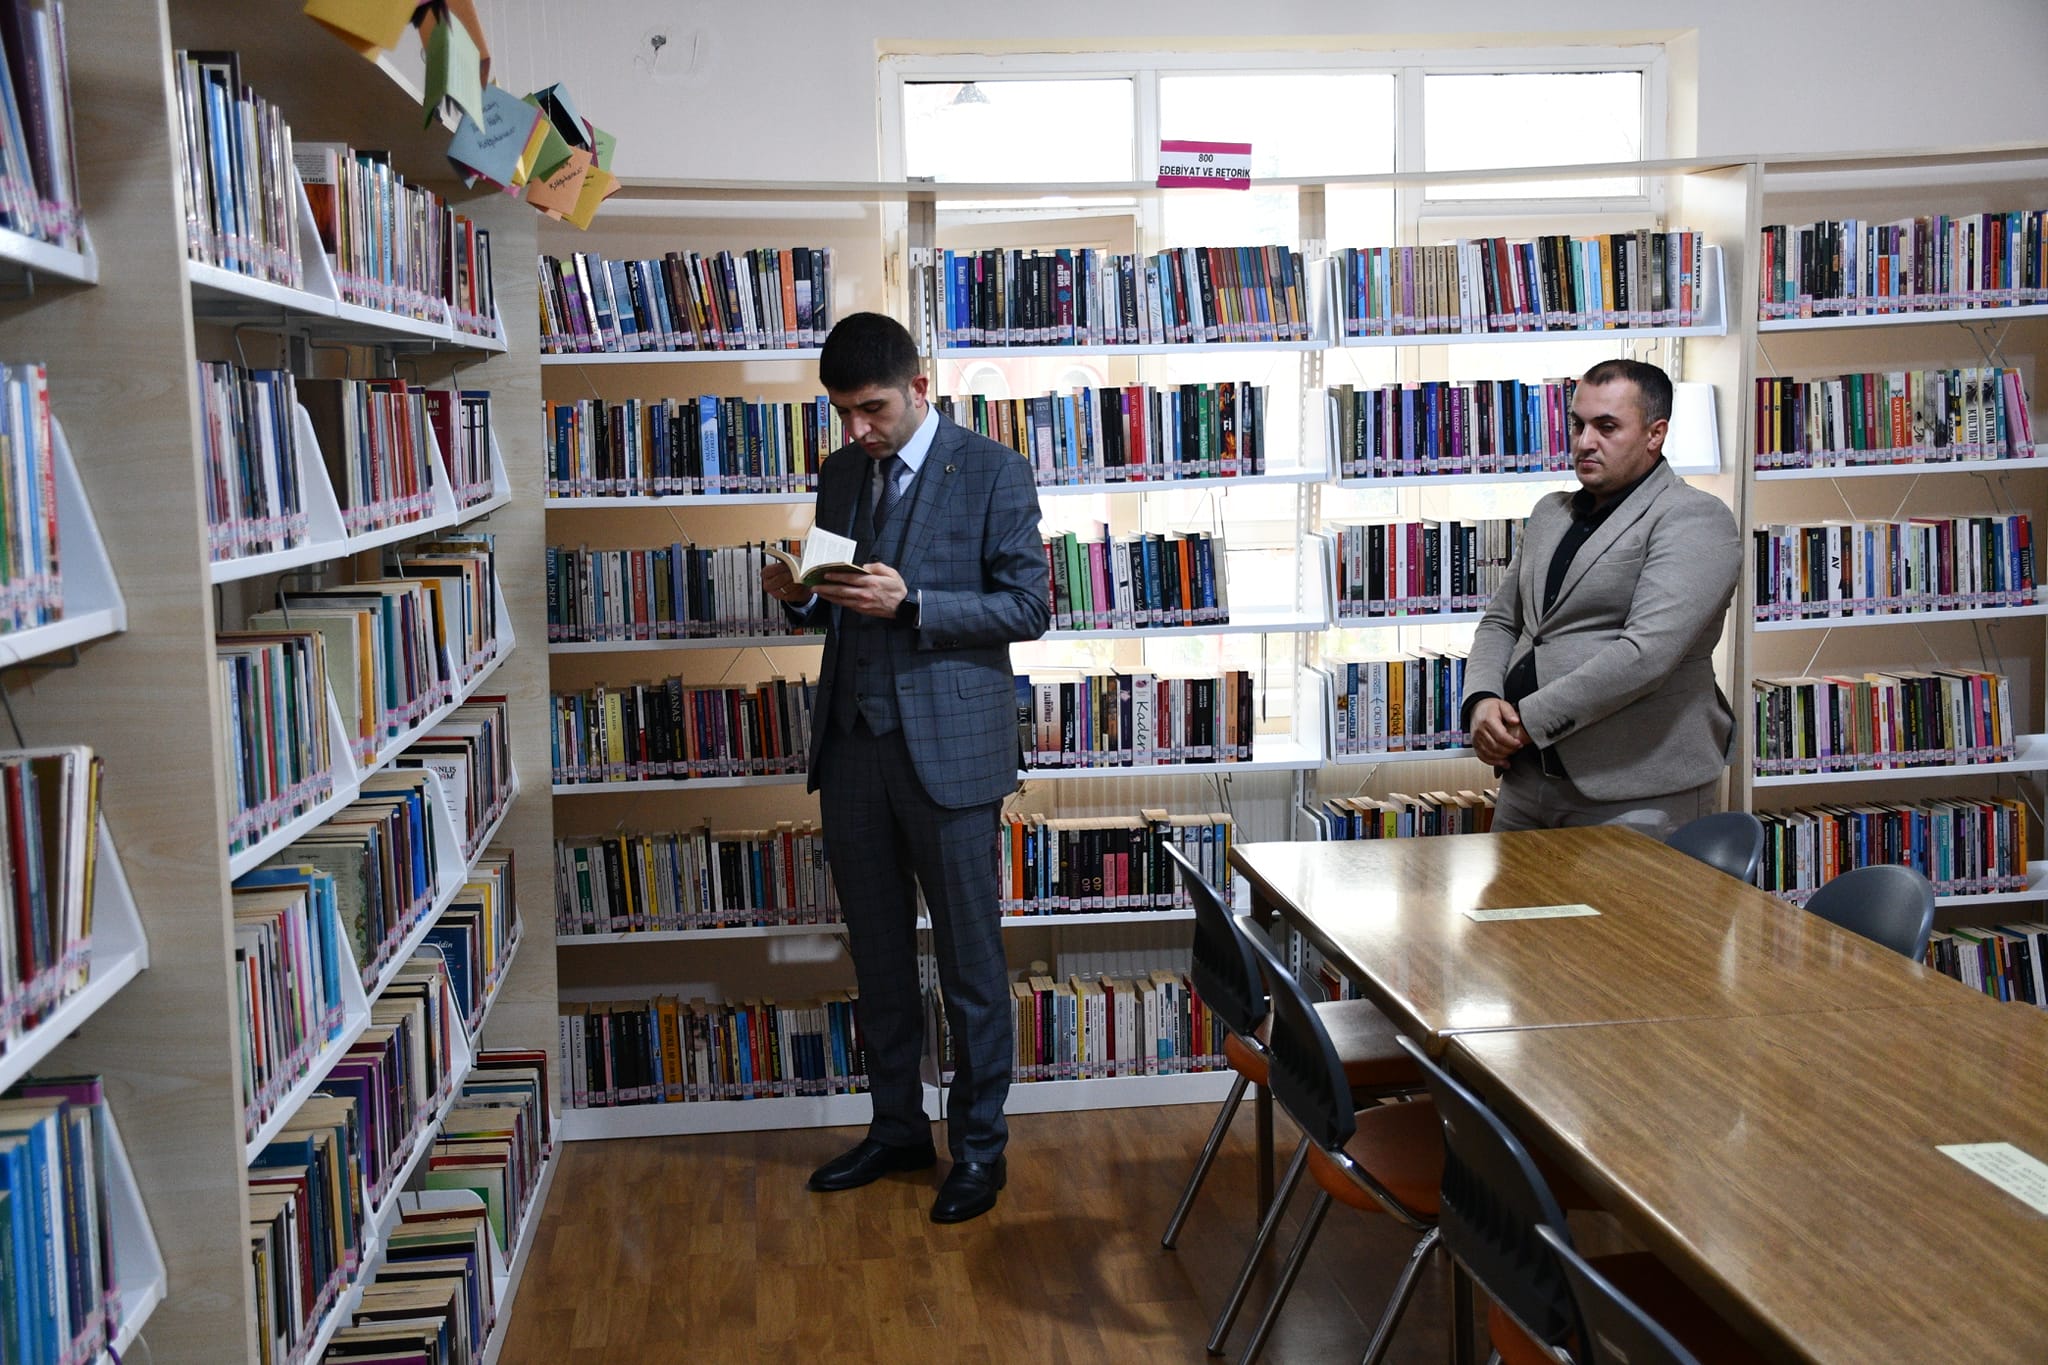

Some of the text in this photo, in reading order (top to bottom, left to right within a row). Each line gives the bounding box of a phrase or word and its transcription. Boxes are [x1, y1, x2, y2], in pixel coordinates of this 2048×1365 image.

[1198, 153, 1214, 163] 800
[1159, 164, 1251, 178] EDEBİYAT VE RETORİK
[1832, 556, 1839, 569] AV
[671, 685, 680, 722] MANAS
[1137, 701, 1149, 751] Kader
